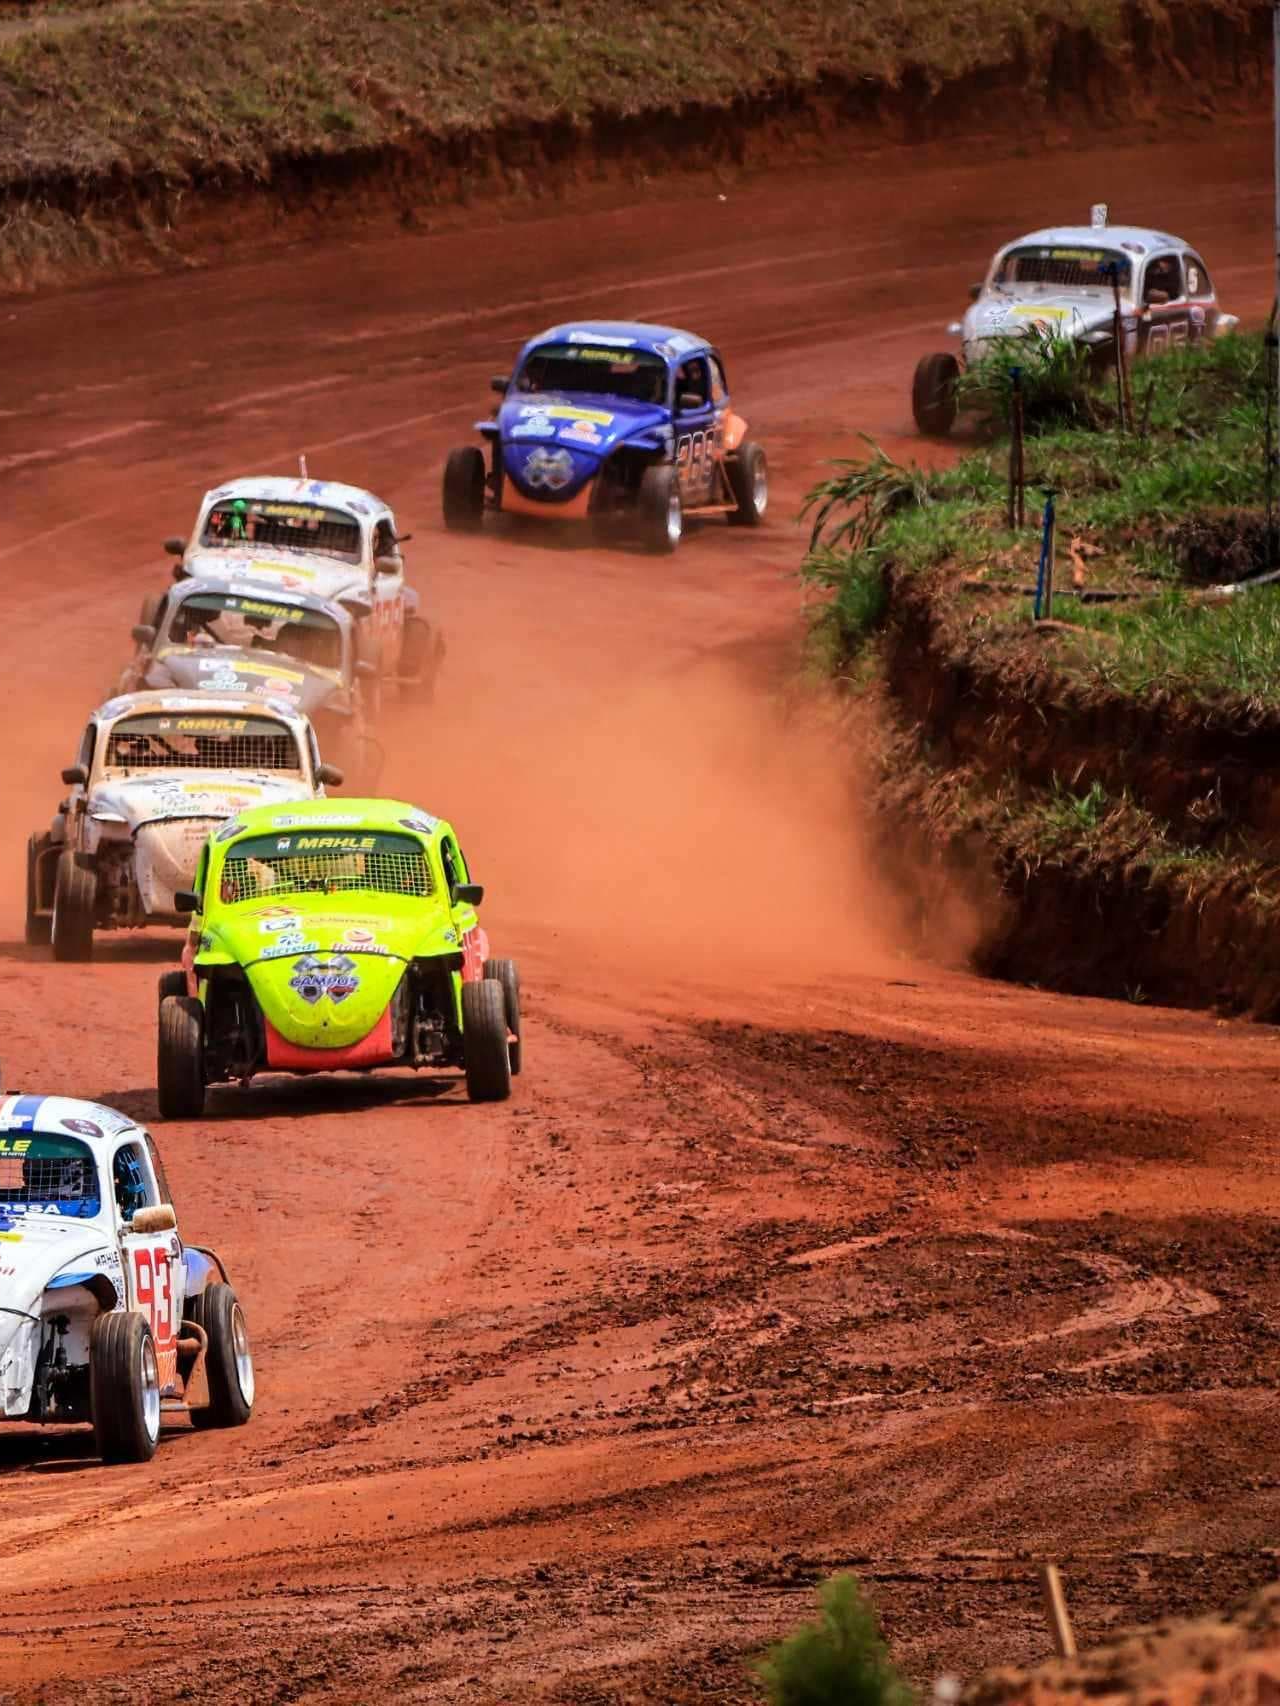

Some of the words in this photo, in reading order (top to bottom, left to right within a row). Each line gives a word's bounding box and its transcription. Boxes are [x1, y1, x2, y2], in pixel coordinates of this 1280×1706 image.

[176, 719, 248, 730] MAHLE
[297, 837, 376, 849] MAHLE
[134, 1247, 173, 1340] 93
